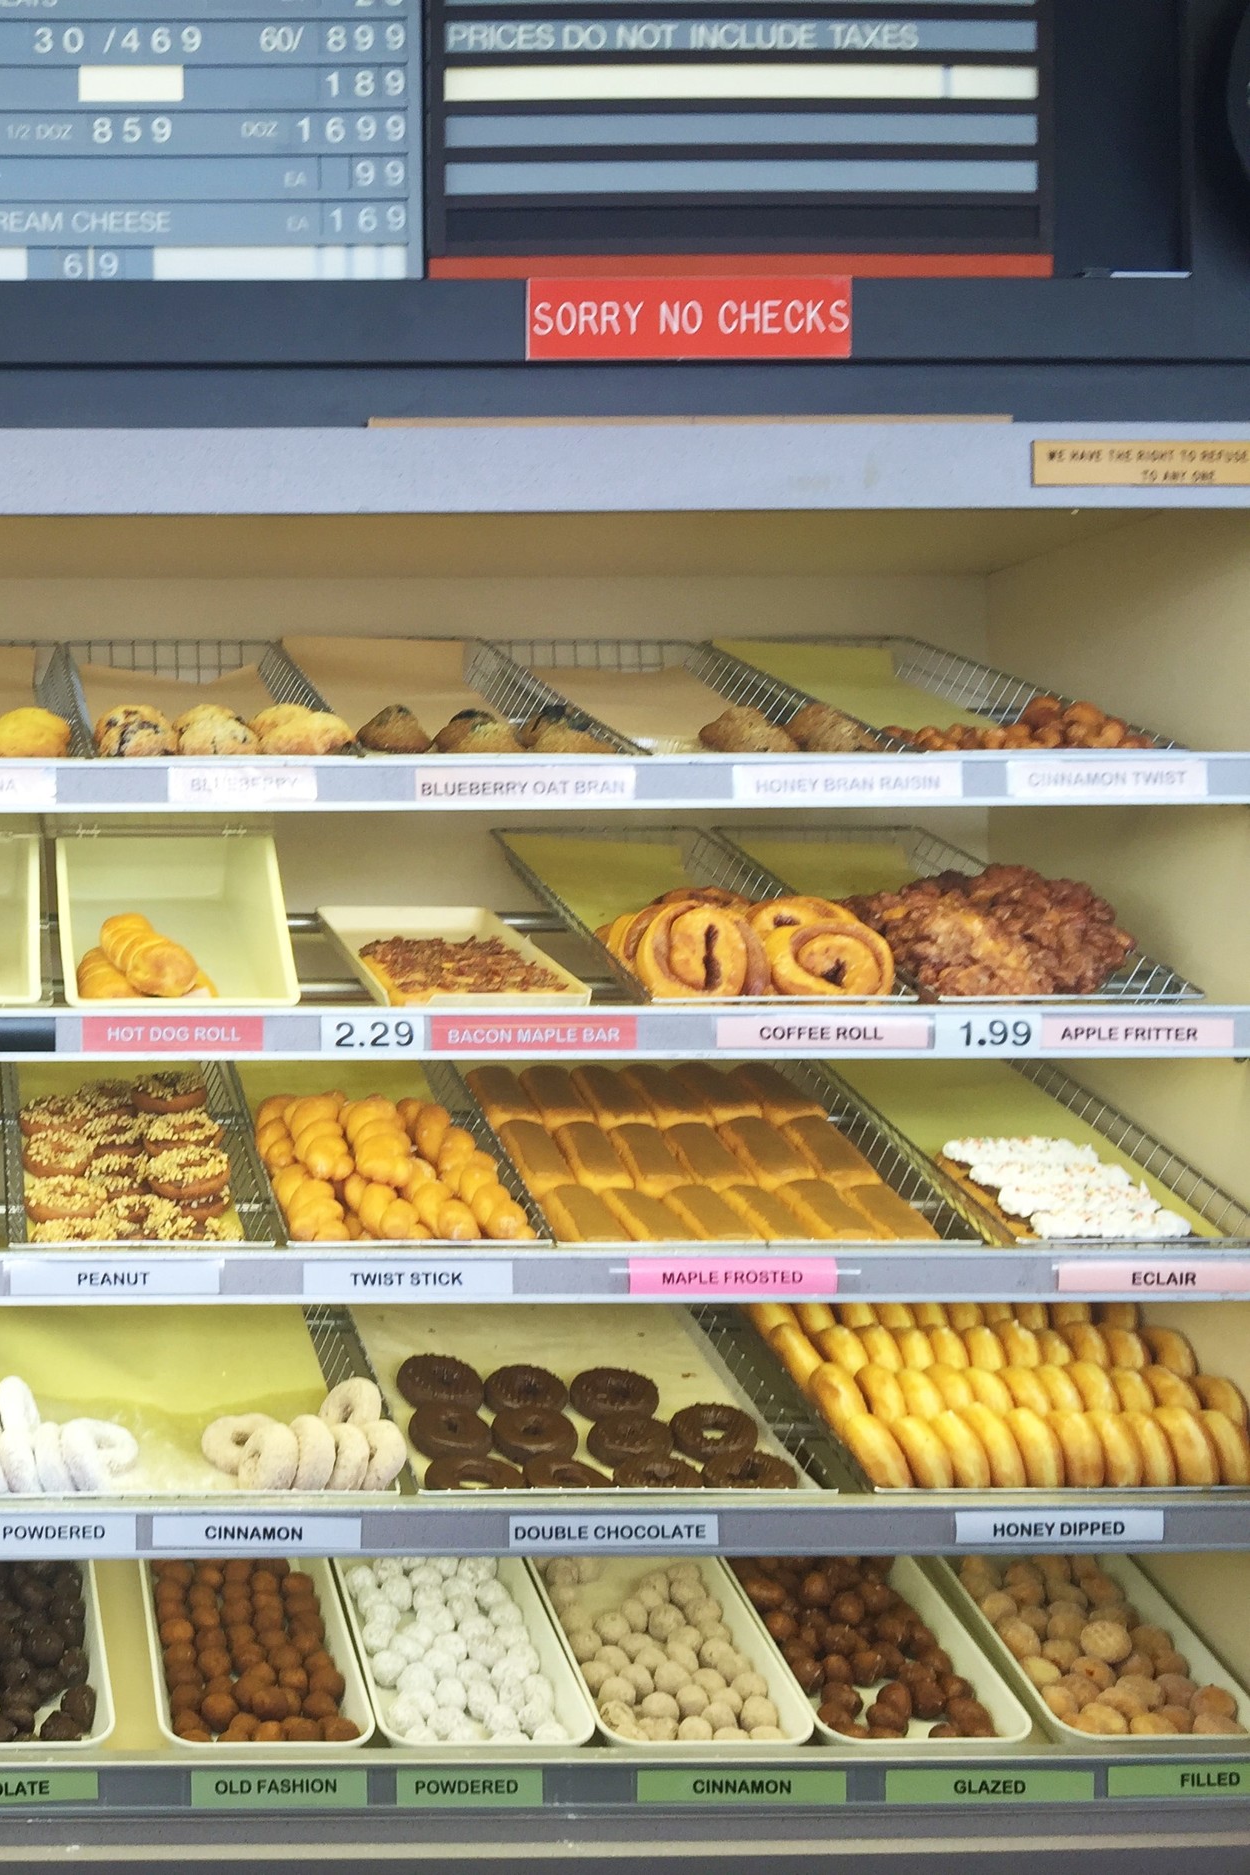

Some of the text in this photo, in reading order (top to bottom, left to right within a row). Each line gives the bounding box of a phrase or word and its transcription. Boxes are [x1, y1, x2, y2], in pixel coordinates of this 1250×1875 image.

[449, 23, 920, 51] PRICES DO NOT INCLUDE TAXES
[71, 210, 172, 233] CHEESE
[533, 299, 850, 336] SORRY NO CHECKS
[1107, 450, 1132, 463] THE
[1180, 449, 1197, 463] TO
[755, 775, 940, 794] HONEY BRAN RAISIN
[1027, 769, 1188, 788] CINNAMON TWIST
[421, 779, 626, 797] BLUEBERRY OAT BRAN
[107, 1026, 242, 1043] HOT DOG ROLL
[334, 1021, 415, 1048] 2.29
[447, 1027, 621, 1044] BACON MAPLE BAR
[759, 1026, 885, 1042] COFFEE ROLL
[960, 1020, 1033, 1047] 1.99
[1061, 1026, 1199, 1042] APPLE FRITTER
[77, 1271, 151, 1287] PEANUT
[350, 1271, 463, 1287] TWIST STICK
[662, 1270, 804, 1286] MAPLE FROSTED
[1132, 1271, 1197, 1286] ECLAIR
[2, 1525, 105, 1541] POWDERED
[204, 1526, 304, 1542] CINNAMON
[514, 1523, 707, 1541] DOUBLE CHOCOLATE
[992, 1520, 1125, 1538] HONEY DIPPED
[215, 1779, 338, 1795] OLD FASHION
[415, 1779, 518, 1795] POWDERED
[692, 1779, 792, 1795] CINNAMON
[953, 1779, 1026, 1795] GLAZED
[1180, 1771, 1240, 1787] FILLED
